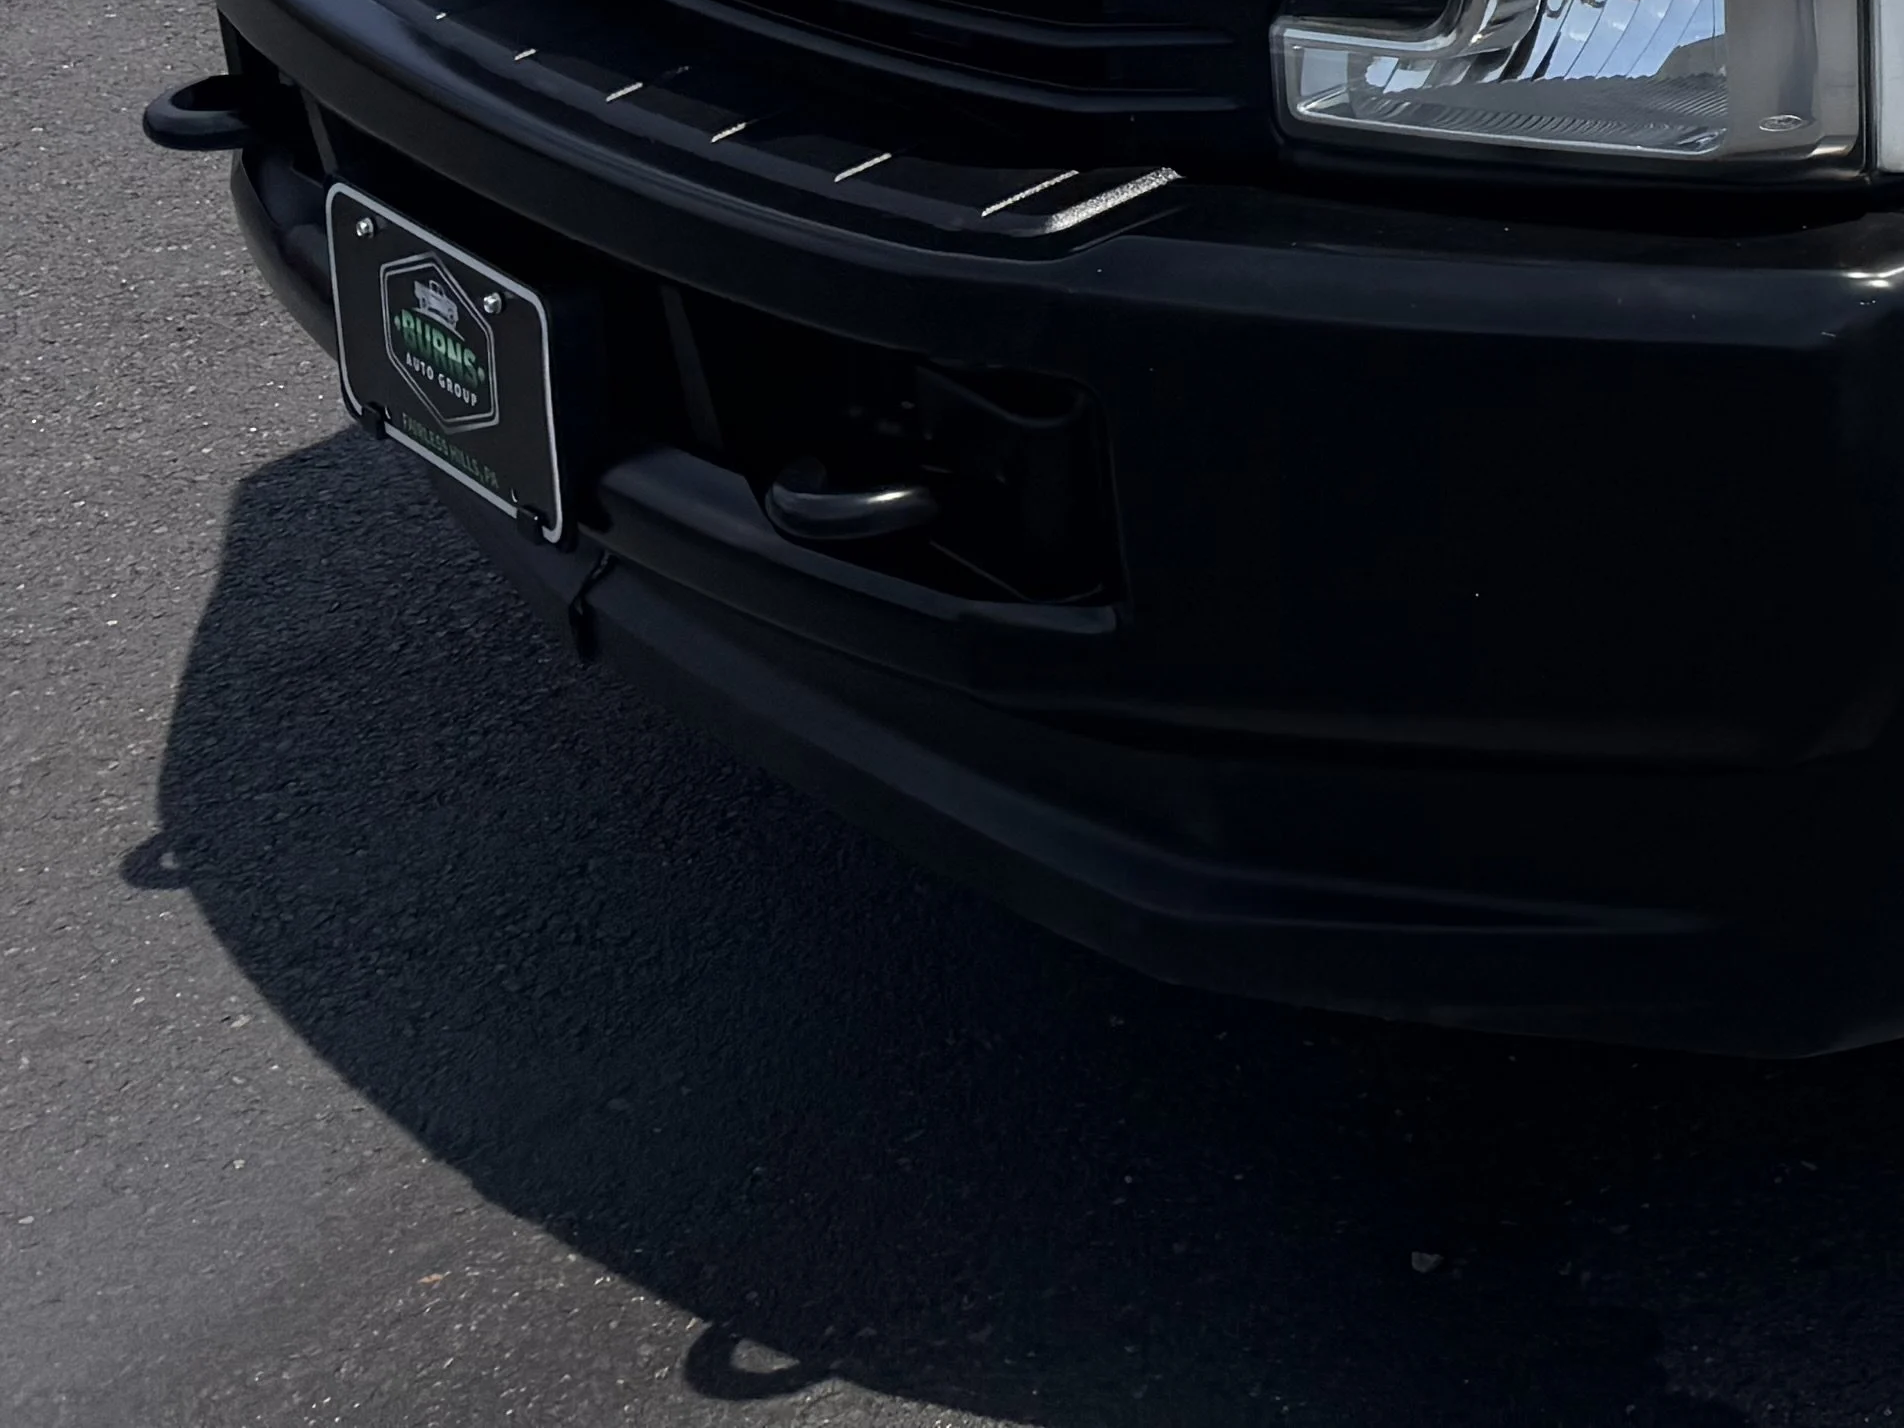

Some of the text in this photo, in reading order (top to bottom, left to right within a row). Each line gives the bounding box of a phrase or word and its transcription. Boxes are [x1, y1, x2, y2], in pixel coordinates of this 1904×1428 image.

[401, 309, 479, 390] BURNS
[405, 352, 478, 407] AUTO GROUP
